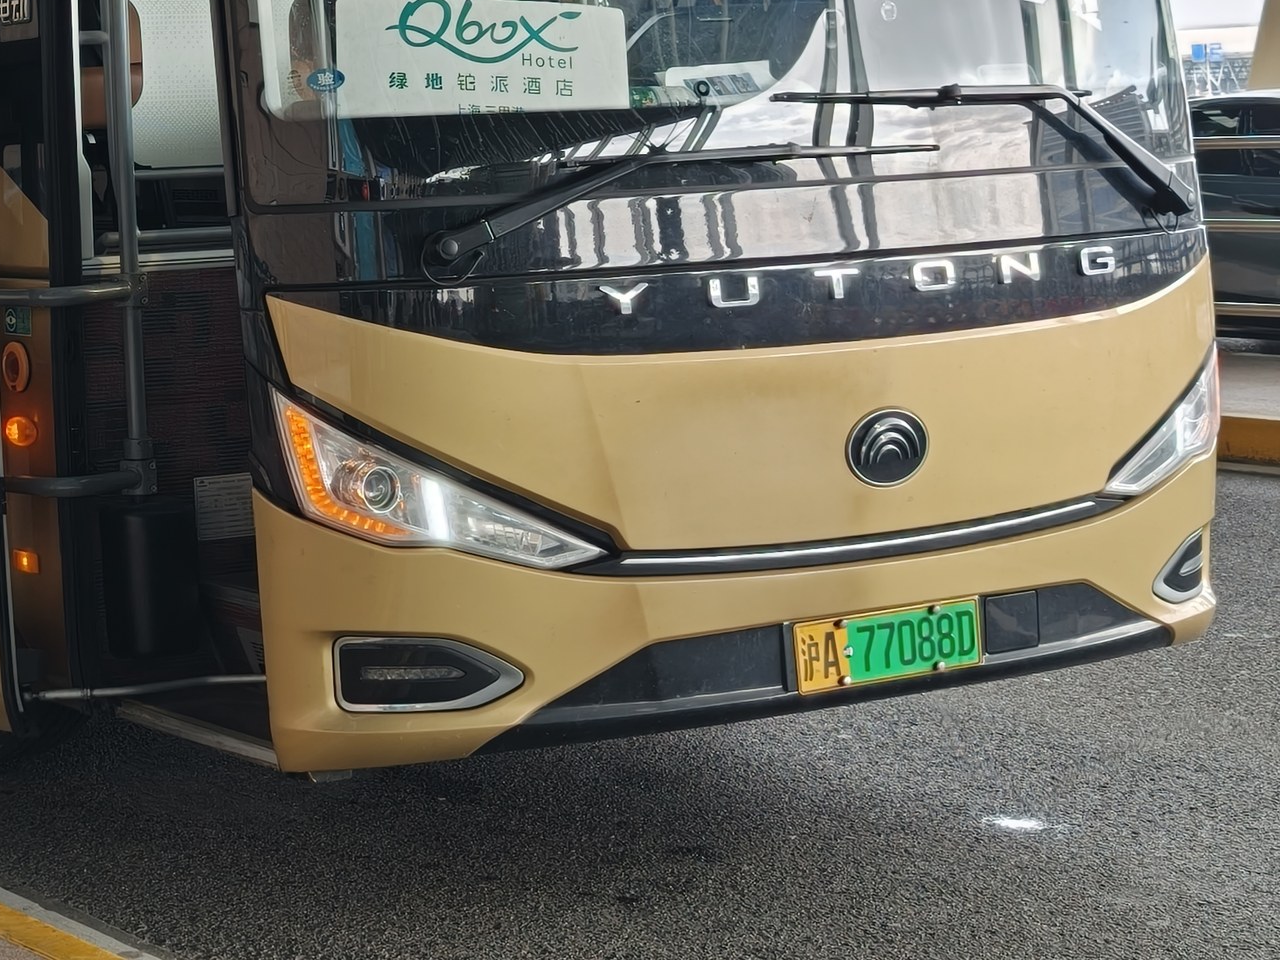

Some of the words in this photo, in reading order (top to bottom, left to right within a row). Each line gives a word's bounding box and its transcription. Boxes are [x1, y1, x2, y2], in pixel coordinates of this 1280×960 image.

[521, 53, 573, 70] Hotel
[317, 72, 334, 86] 验
[388, 71, 574, 97] 绿地铂派酒店
[598, 245, 1116, 315] YUTONG
